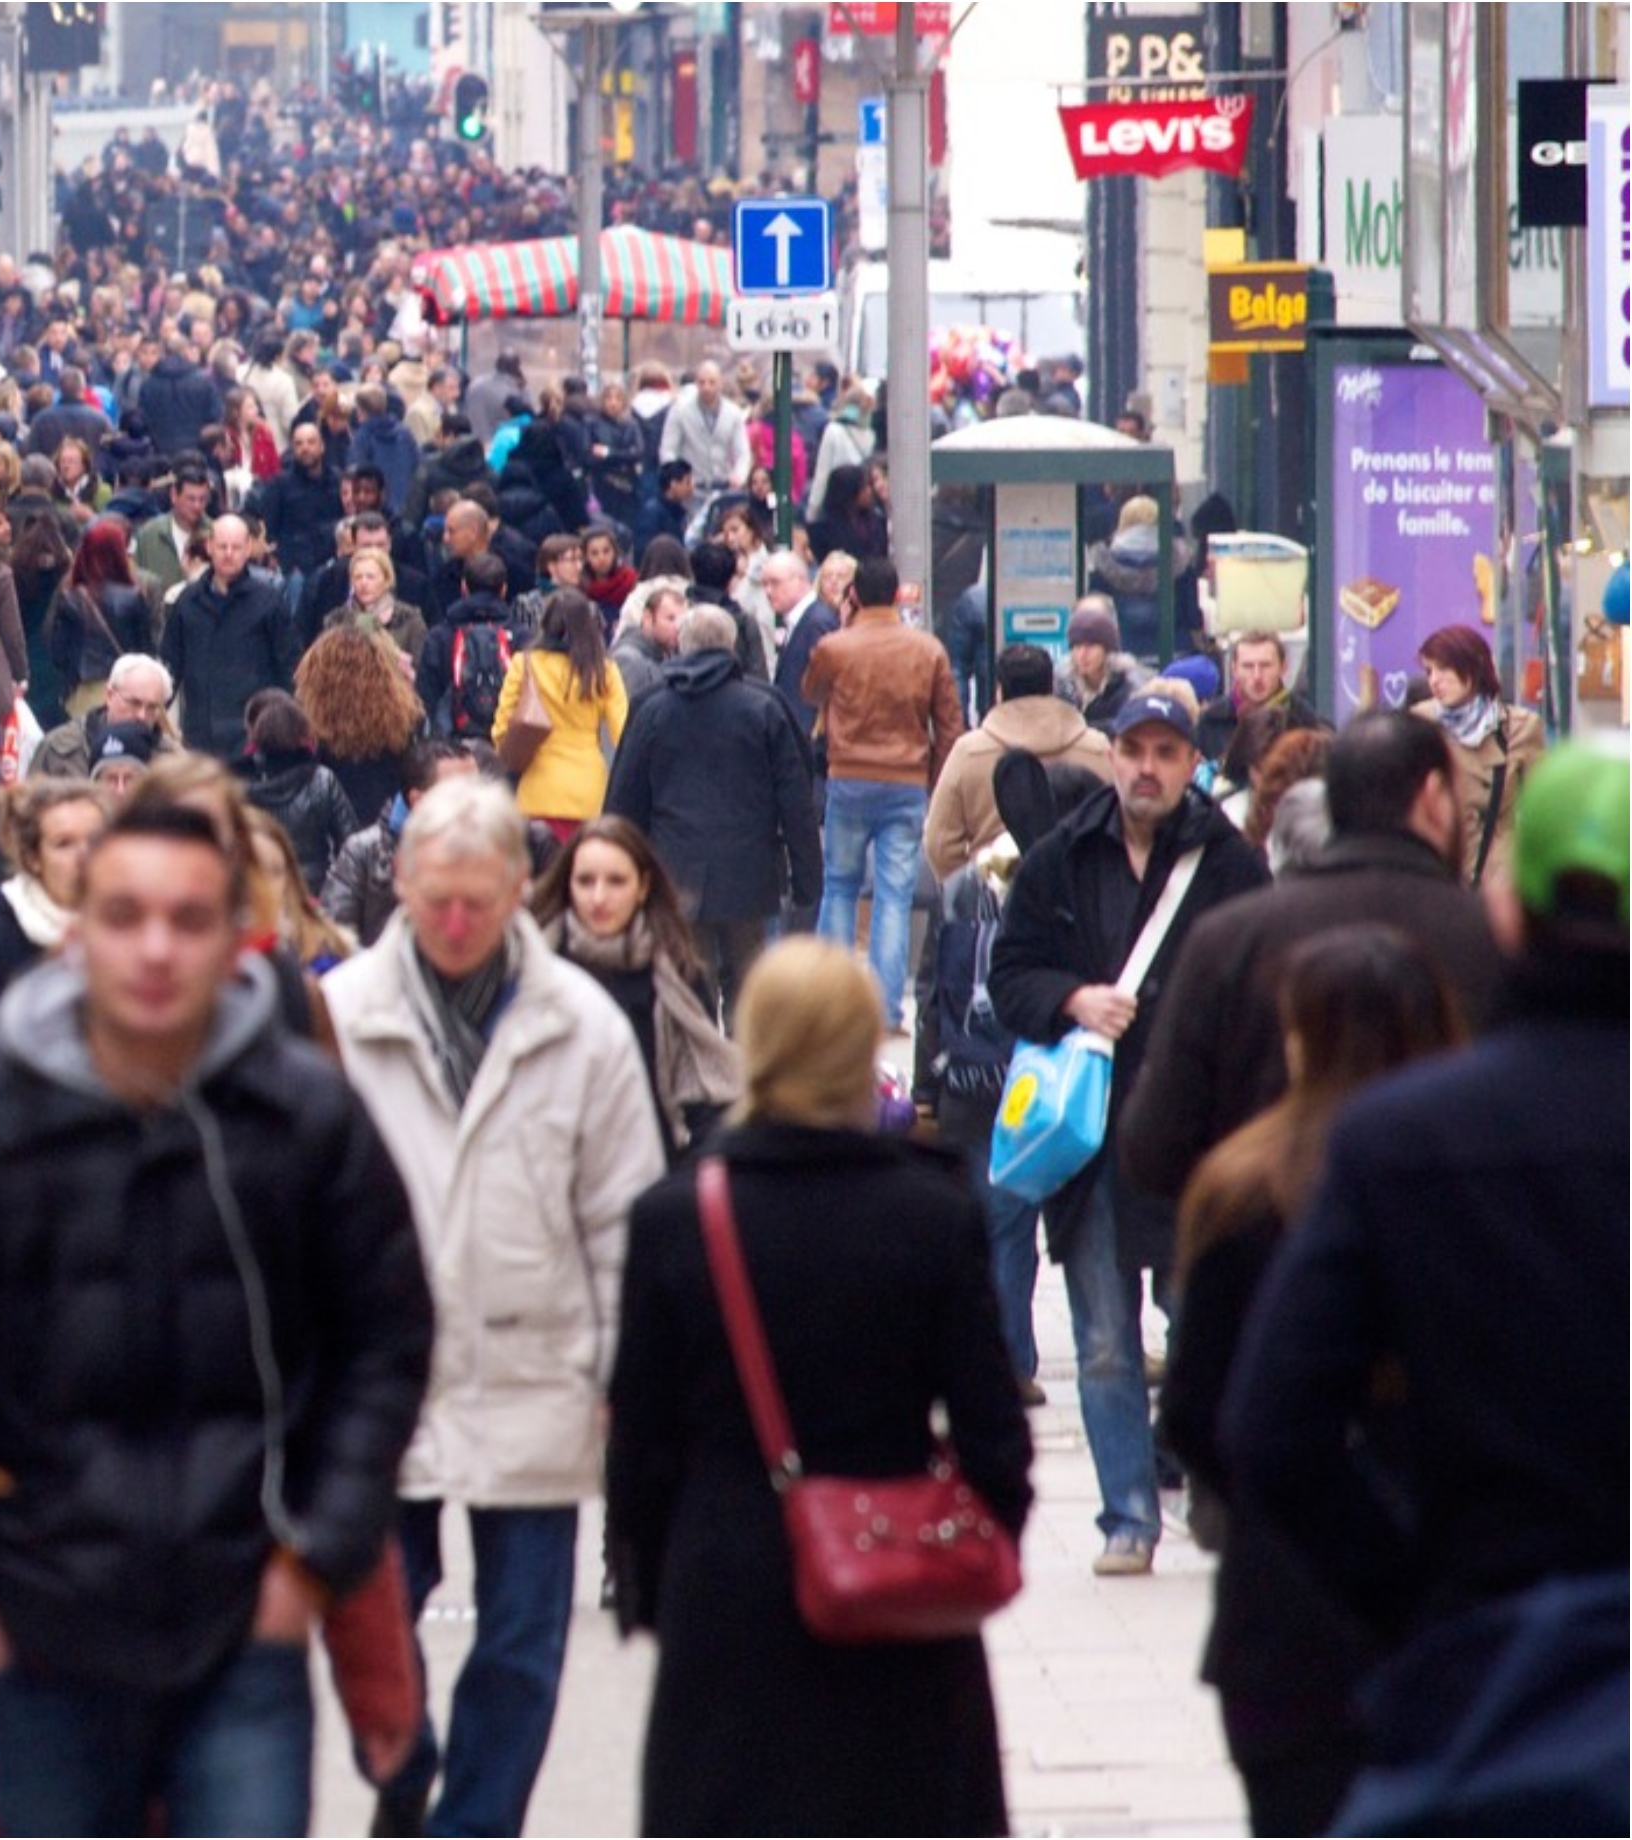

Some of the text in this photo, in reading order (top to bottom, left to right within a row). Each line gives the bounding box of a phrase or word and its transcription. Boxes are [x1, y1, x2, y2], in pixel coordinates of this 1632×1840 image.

[1350, 446, 1431, 472] Prenons
[1433, 444, 1451, 472] le
[1363, 477, 1388, 504] de
[1392, 476, 1475, 504] biscuiter
[1397, 508, 1470, 536] famille.
